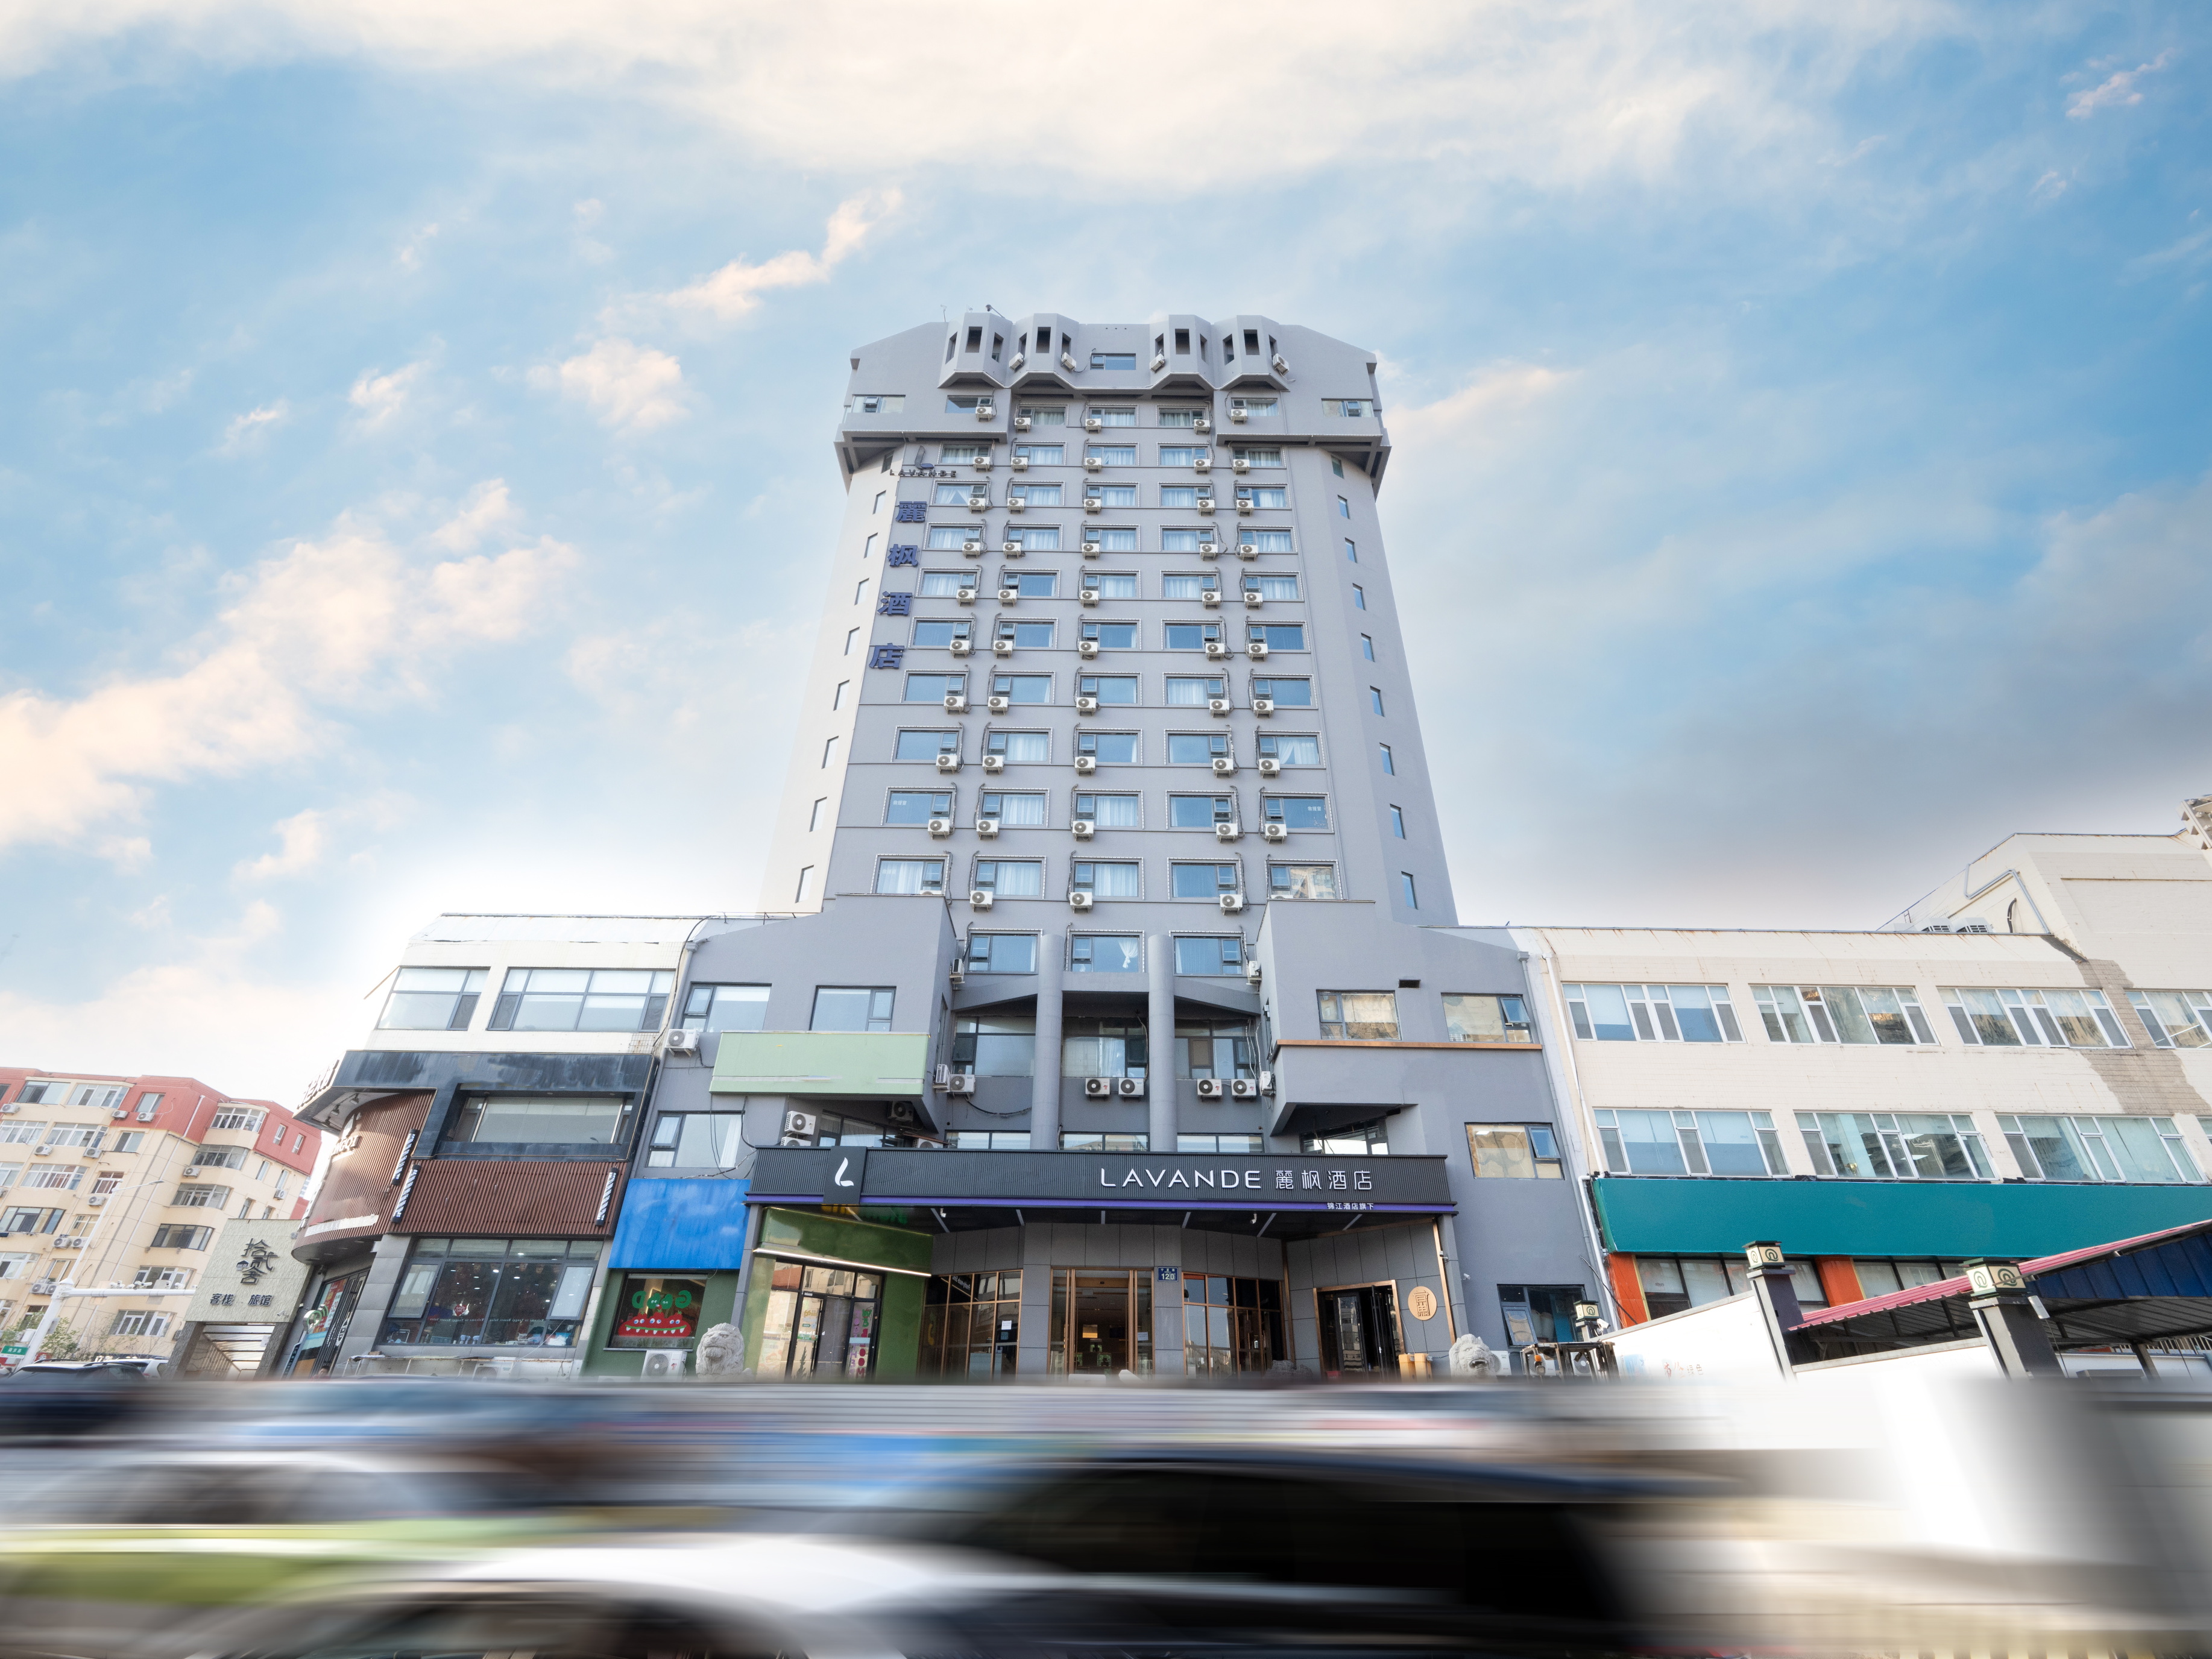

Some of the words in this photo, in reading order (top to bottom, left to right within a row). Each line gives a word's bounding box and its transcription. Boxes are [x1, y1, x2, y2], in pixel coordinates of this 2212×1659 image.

[889, 468, 957, 478] LAVANDE
[1101, 1167, 1262, 1189] LAVANDE
[1275, 1169, 1372, 1191] 麗枫酒店
[1326, 1202, 1374, 1210] 锦江酒店旗下
[210, 1293, 234, 1306] 客栈
[248, 1294, 273, 1306] 旅馆
